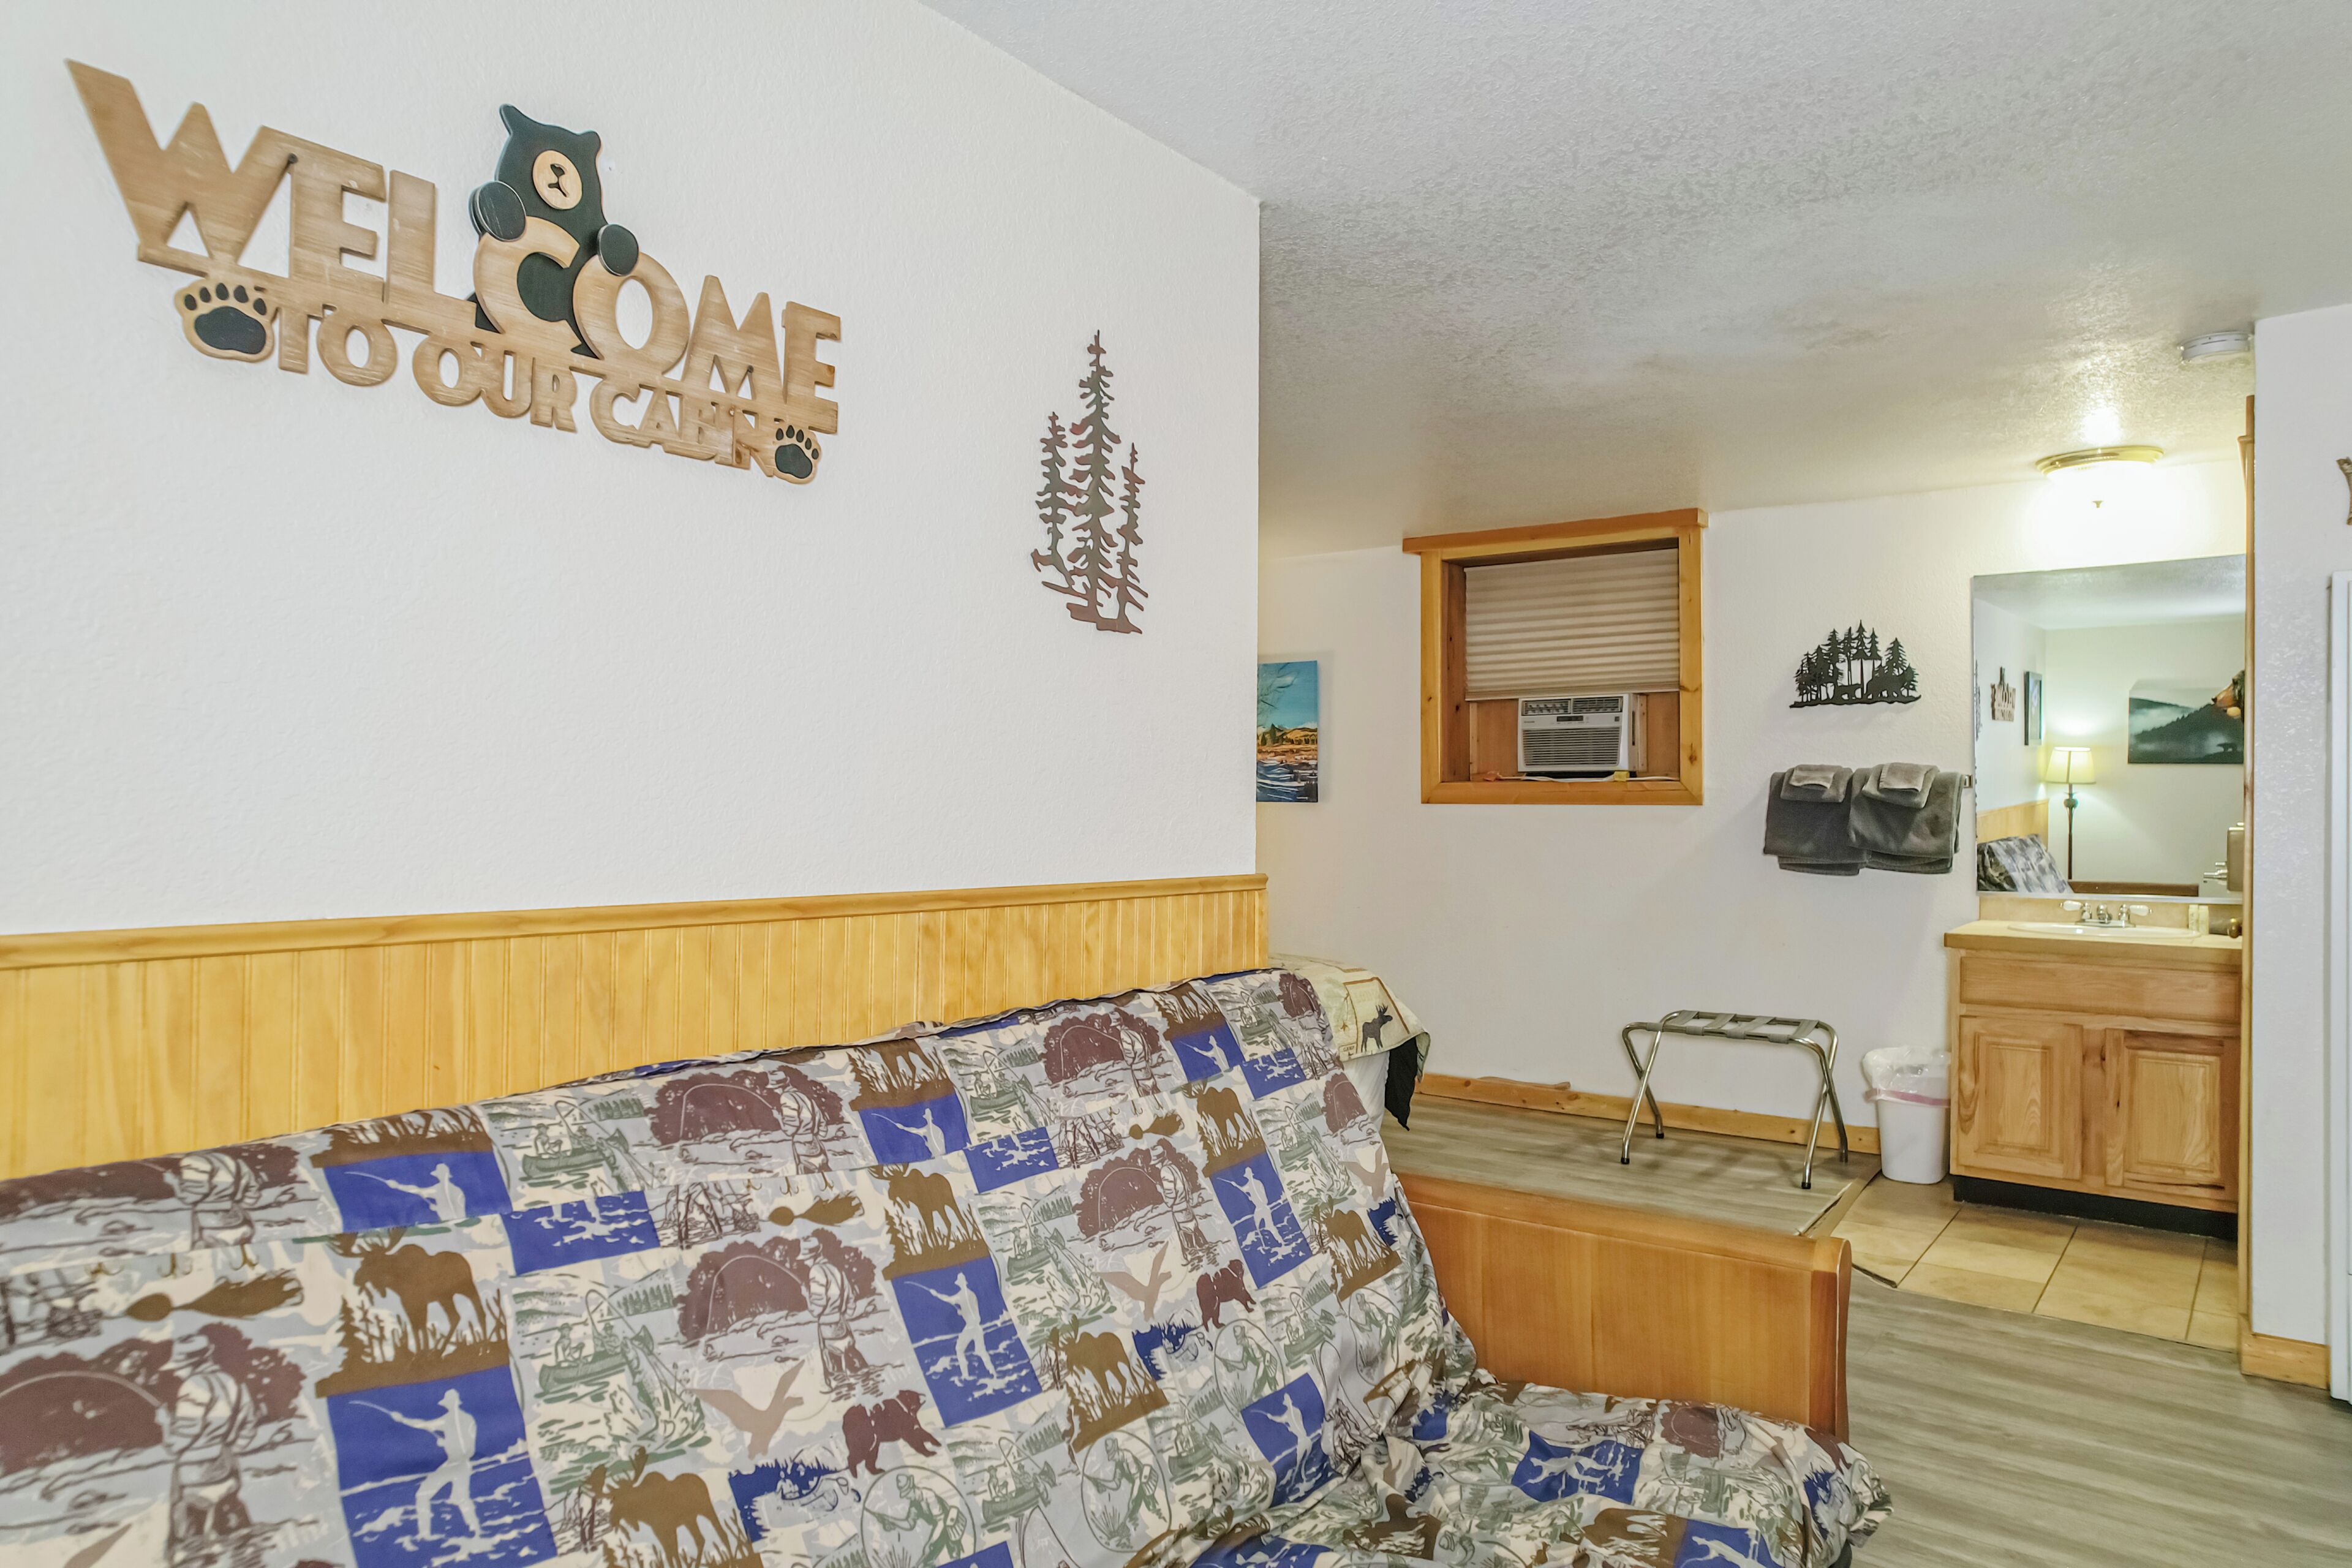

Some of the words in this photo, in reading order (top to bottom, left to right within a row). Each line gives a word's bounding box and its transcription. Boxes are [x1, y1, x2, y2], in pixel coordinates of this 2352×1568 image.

[66, 58, 841, 435] WELCOME
[273, 294, 398, 386] TO
[412, 328, 578, 433] OUR
[589, 370, 779, 478] CABIN
